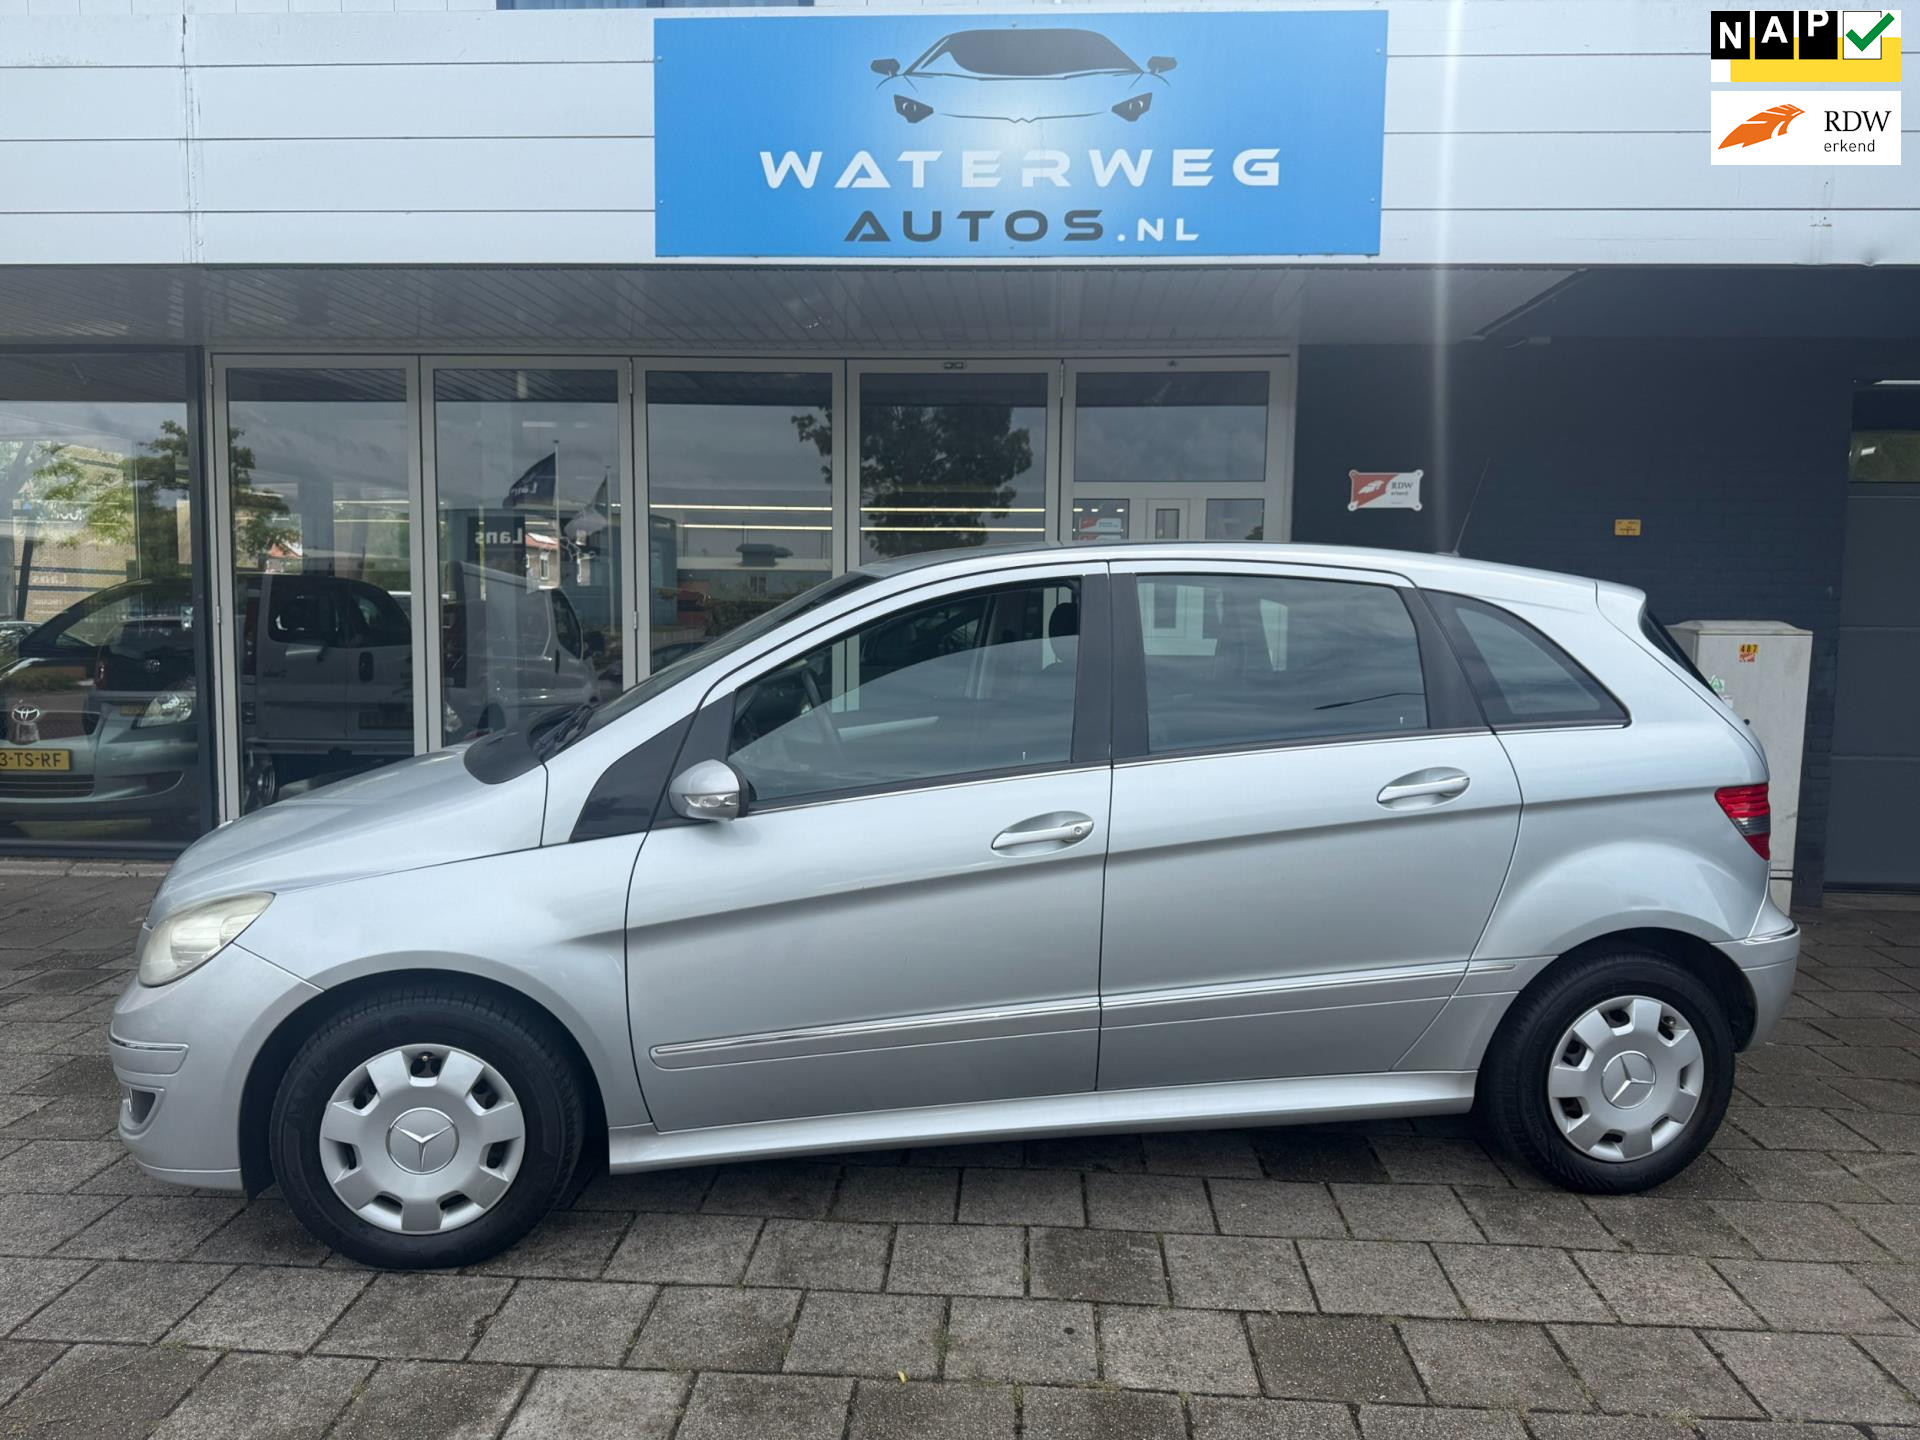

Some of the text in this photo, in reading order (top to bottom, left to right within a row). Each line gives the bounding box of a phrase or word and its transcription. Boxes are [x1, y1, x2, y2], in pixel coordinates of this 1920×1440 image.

[758, 148, 1281, 189] WATERWEG
[843, 209, 1200, 243] AUTOS.NL
[1391, 481, 1413, 489] RDW
